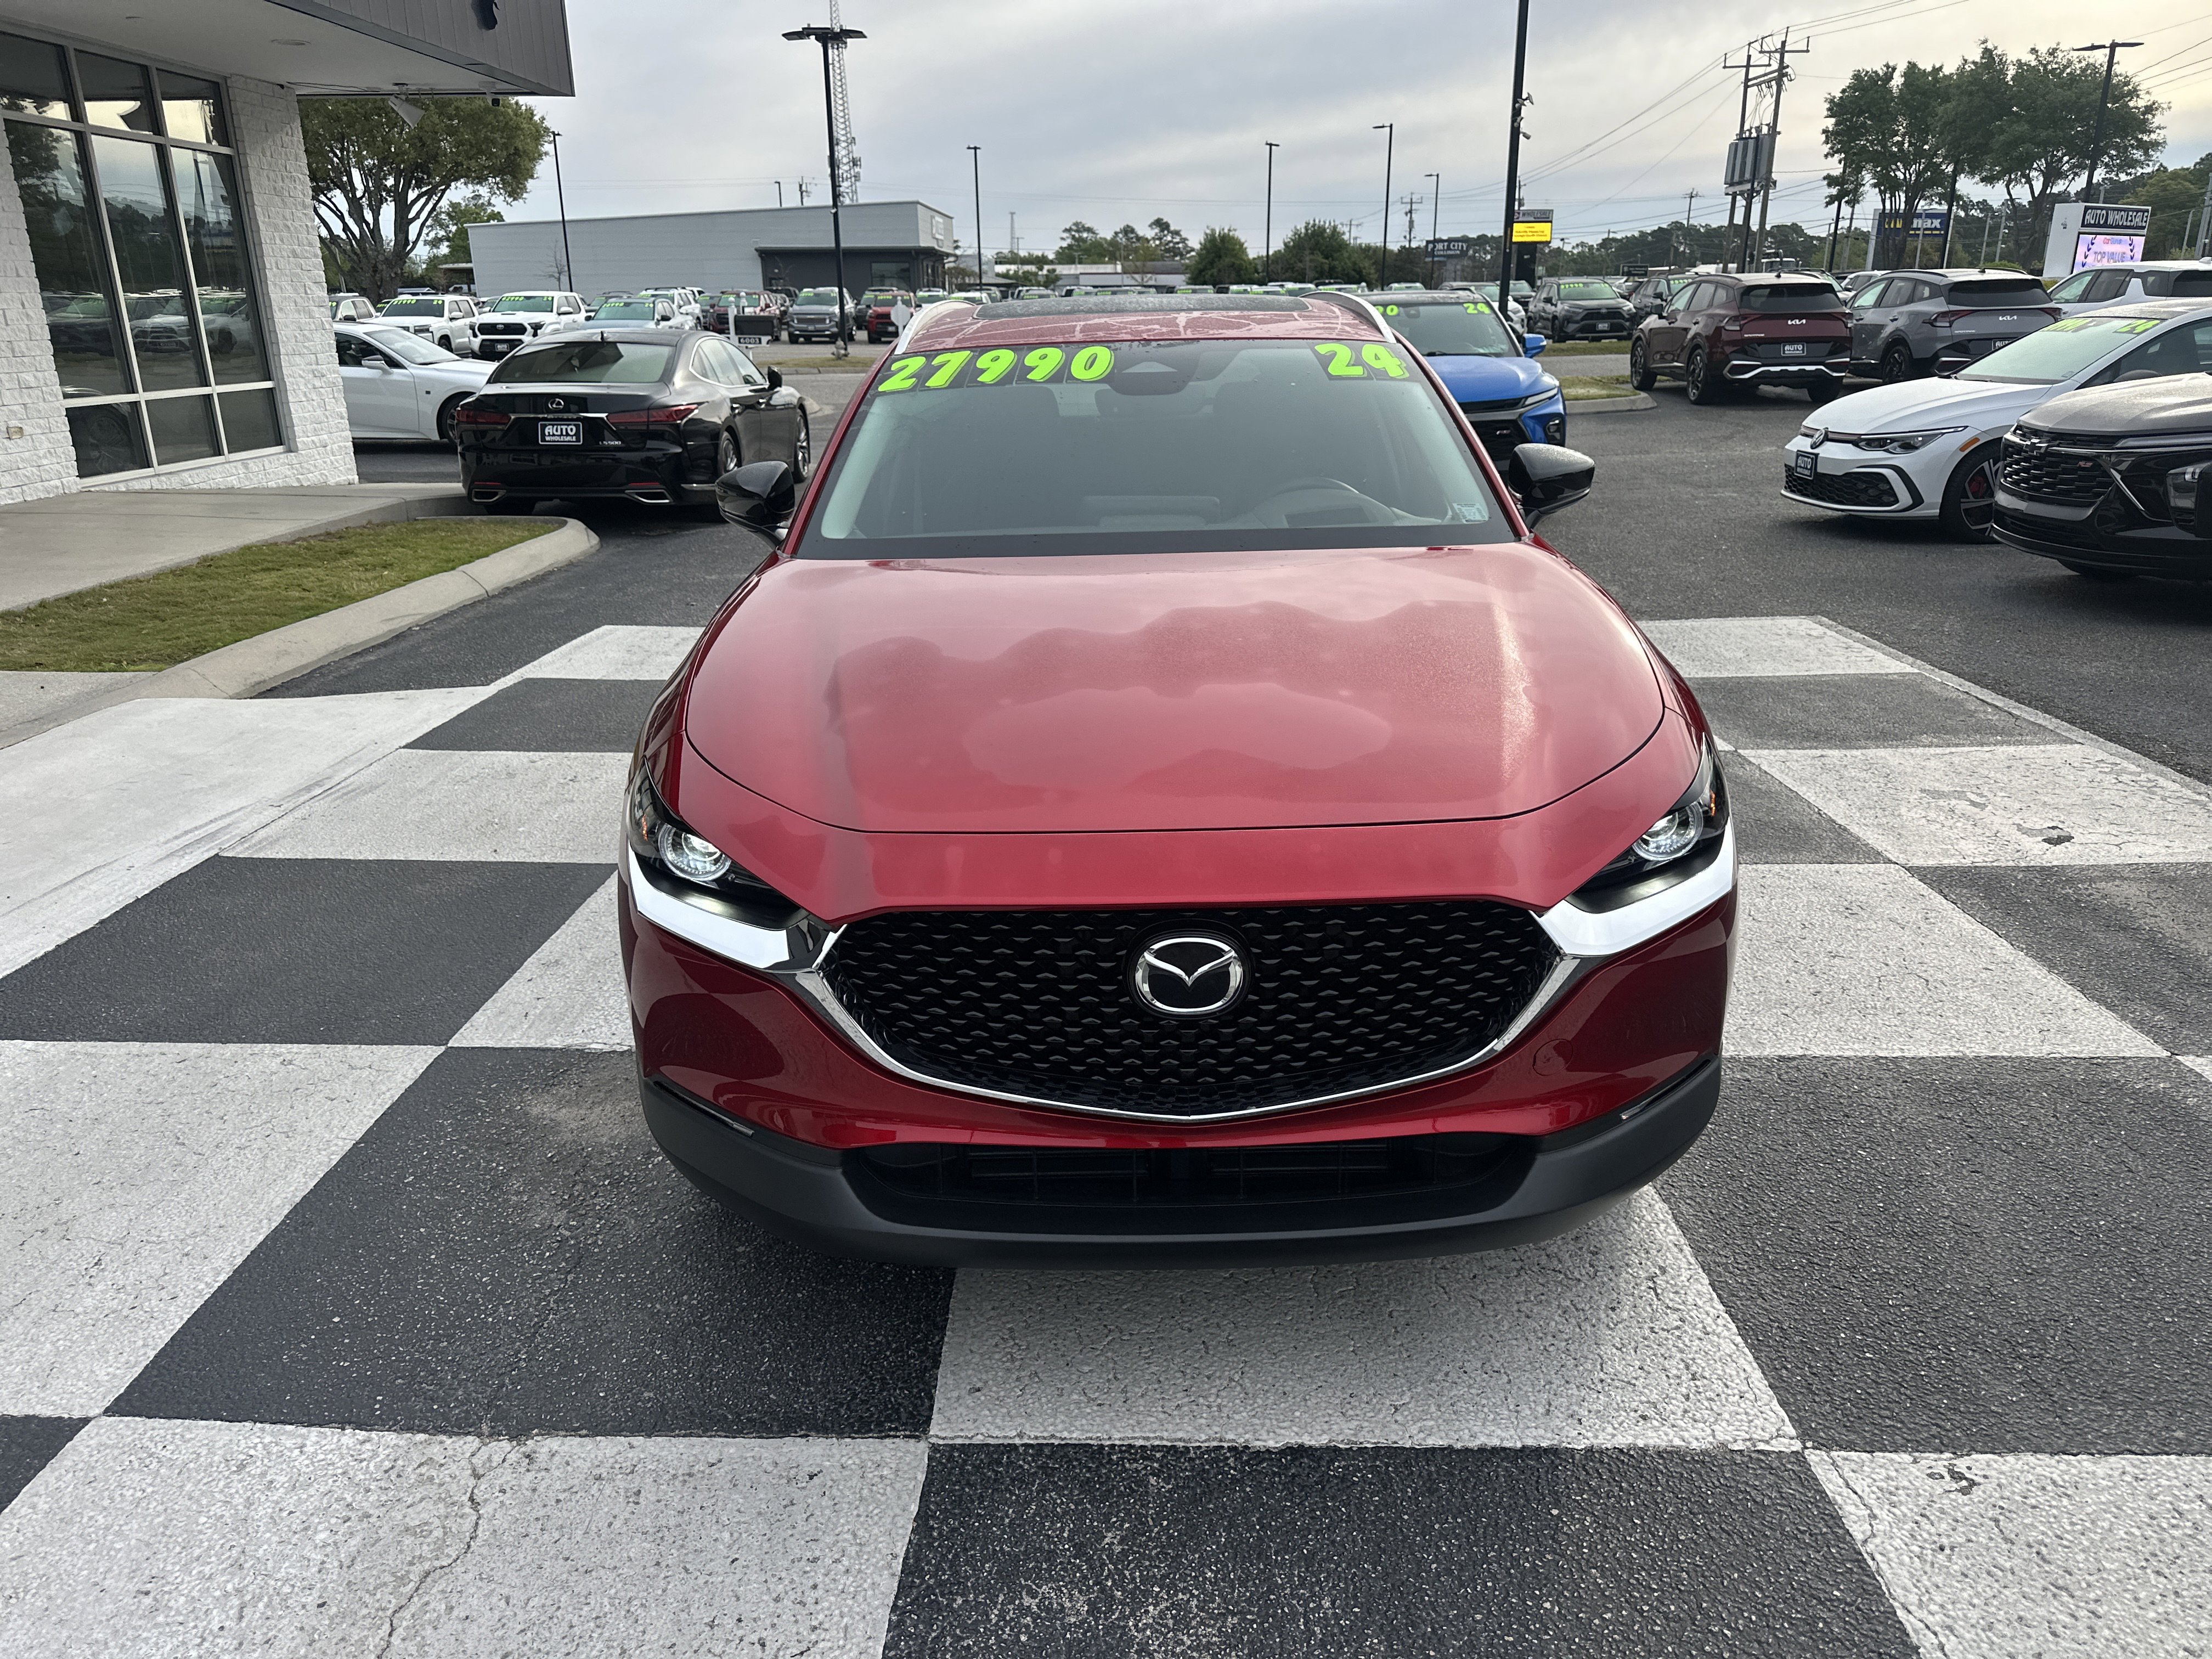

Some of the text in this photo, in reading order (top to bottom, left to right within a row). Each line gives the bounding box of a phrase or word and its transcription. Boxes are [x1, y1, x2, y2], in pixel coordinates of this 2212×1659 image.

[2084, 209, 2148, 227] AUTO WHOLESALE
[1427, 242, 1468, 252] PORT CITY
[2093, 251, 2126, 263] TOP VALUE
[1463, 303, 1491, 314] 24
[2116, 320, 2160, 334] 24
[878, 343, 1409, 392] 27990 24
[545, 425, 576, 436] AUTO
[1798, 456, 1812, 469] AUTO
